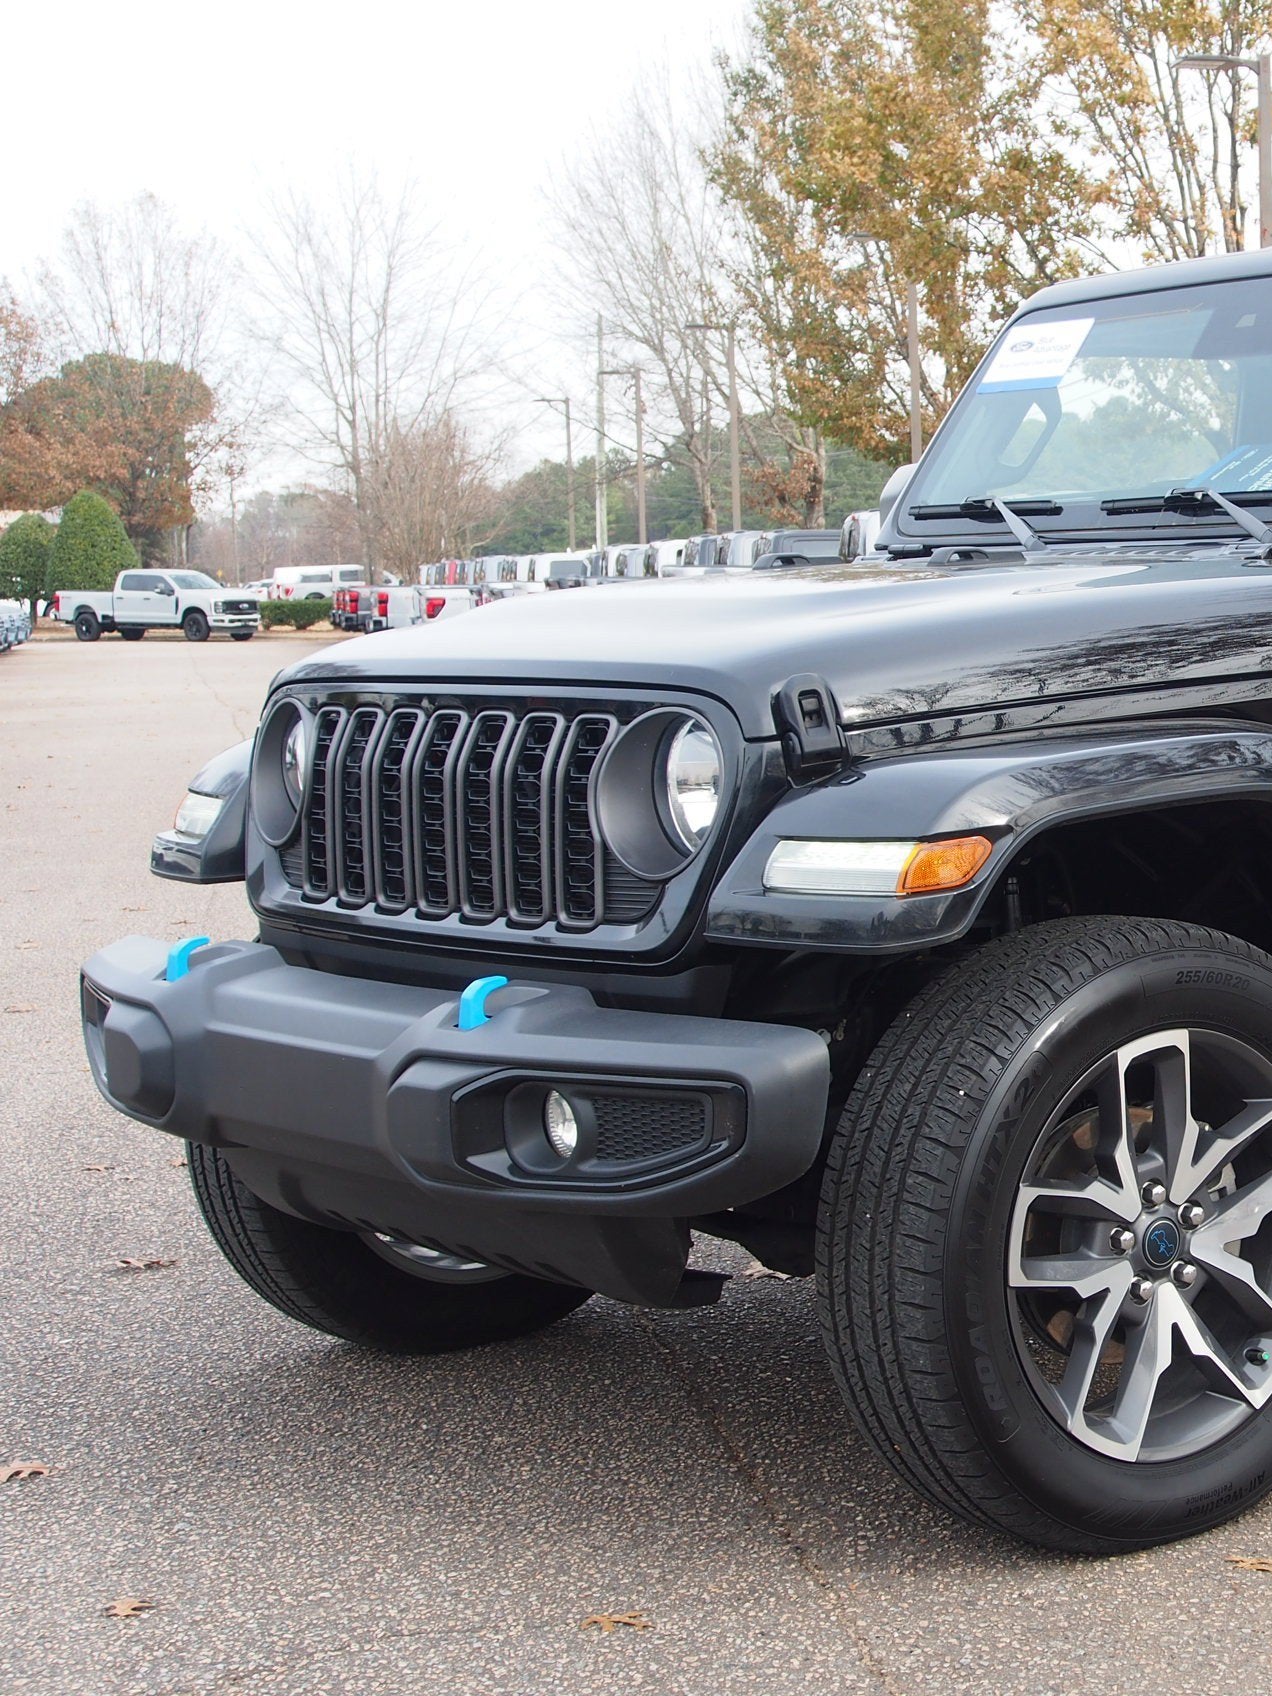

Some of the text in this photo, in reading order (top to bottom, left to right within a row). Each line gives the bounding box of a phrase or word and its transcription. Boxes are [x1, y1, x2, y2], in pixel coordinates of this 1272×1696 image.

[1175, 970, 1251, 991] 255/60R20
[1184, 1469, 1266, 1519] All-Weather
[1186, 1481, 1233, 1506] Performance
